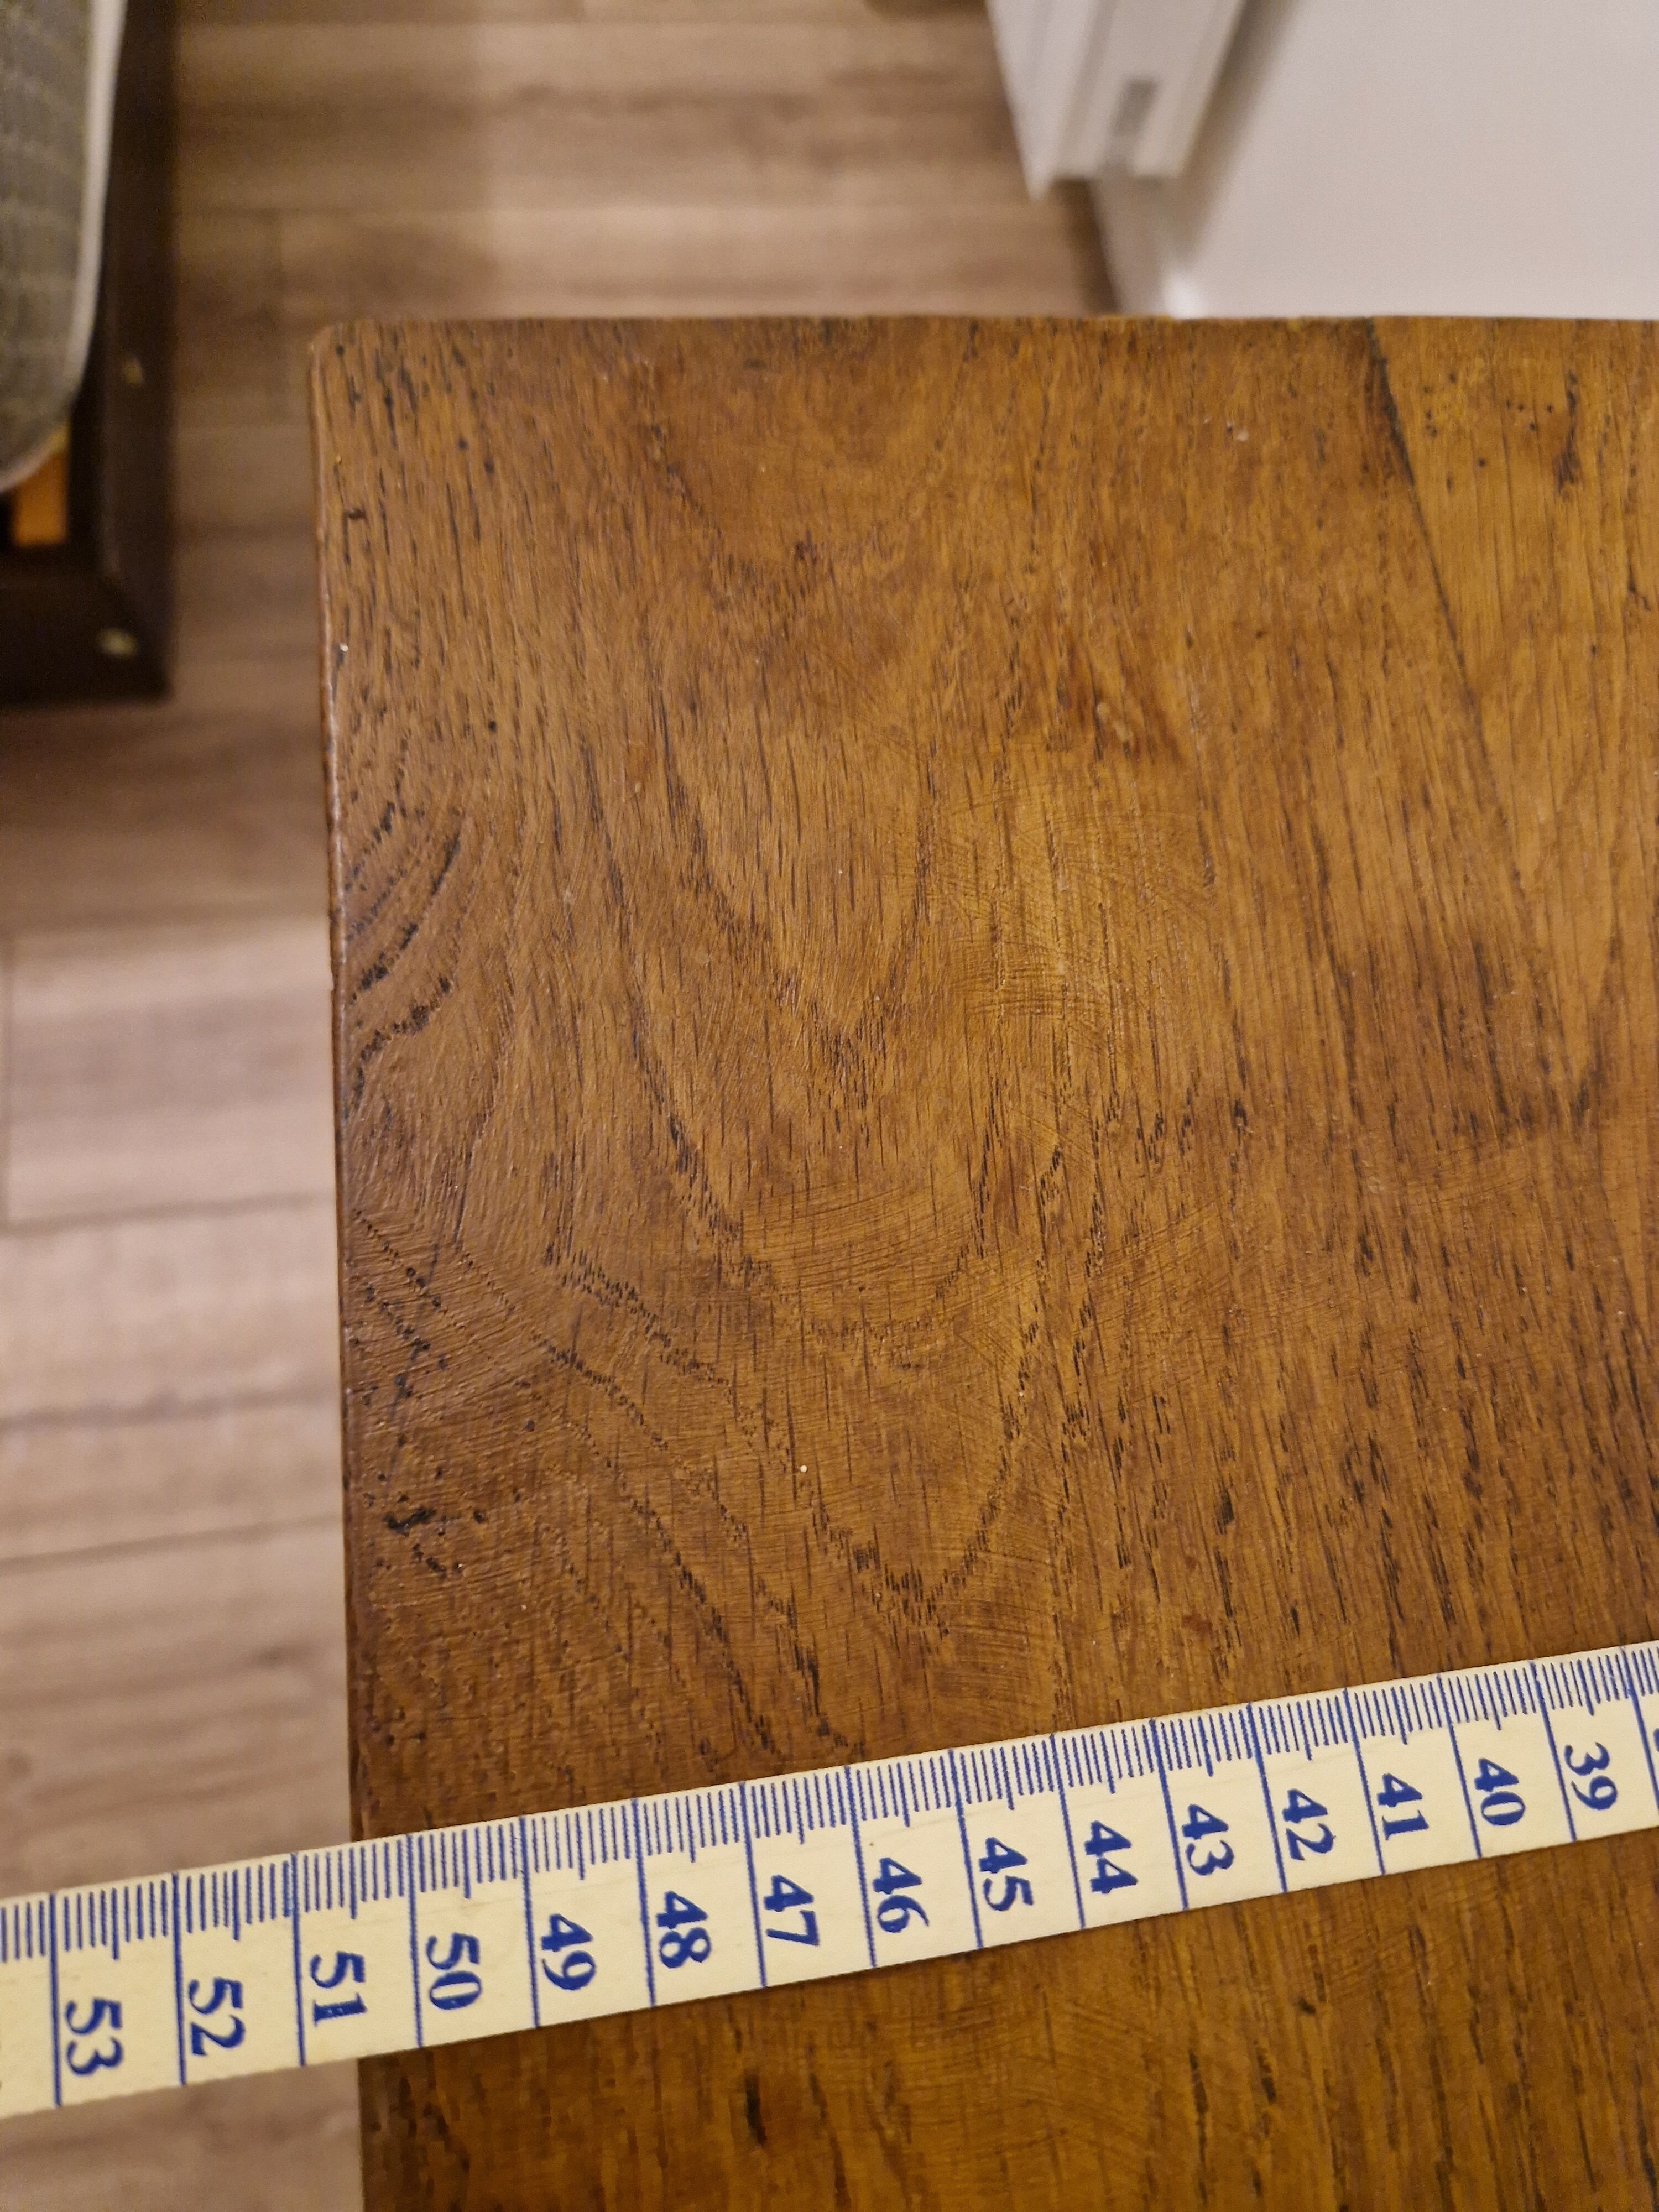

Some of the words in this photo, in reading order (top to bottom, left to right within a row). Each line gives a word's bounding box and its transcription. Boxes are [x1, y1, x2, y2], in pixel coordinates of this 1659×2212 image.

[1376, 1773, 1429, 1840] 41
[1474, 1758, 1526, 1827] 40
[1563, 1741, 1618, 1811] 39
[1084, 1819, 1138, 1895] 44
[1181, 1803, 1234, 1876] 43
[1282, 1788, 1334, 1861] 42
[763, 1874, 820, 1947] 47
[872, 1856, 929, 1933] 46
[978, 1836, 1034, 1912] 45
[540, 1913, 596, 1991] 49
[655, 1890, 712, 1969] 48
[309, 1951, 367, 2026] 51
[425, 1932, 482, 2011] 50
[64, 1998, 123, 2077] 53
[187, 1977, 246, 2057] 52
